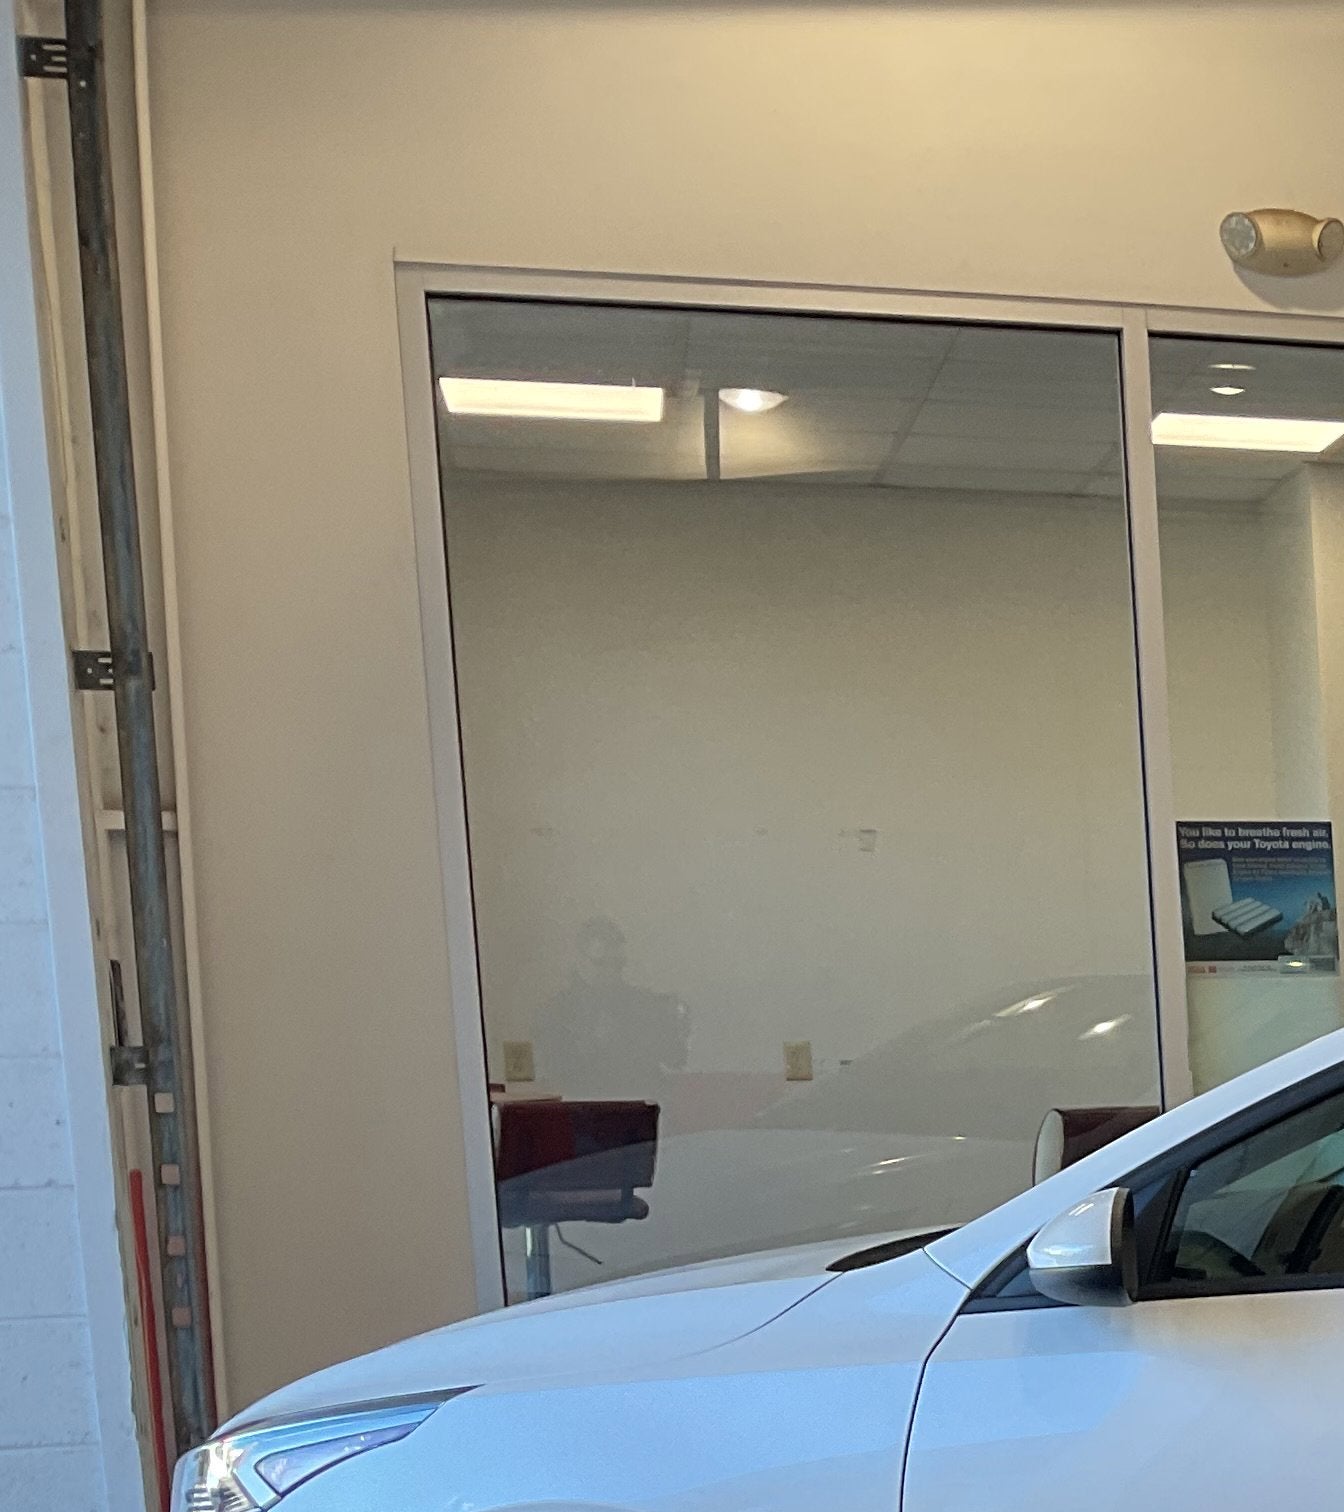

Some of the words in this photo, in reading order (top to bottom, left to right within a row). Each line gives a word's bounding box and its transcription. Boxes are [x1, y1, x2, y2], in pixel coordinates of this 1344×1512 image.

[1202, 827, 1221, 837] like
[1224, 827, 1236, 837] to
[1238, 827, 1280, 837] breathe
[1282, 827, 1309, 837] fresh
[1226, 840, 1251, 851] your
[1253, 838, 1289, 851] Toyota
